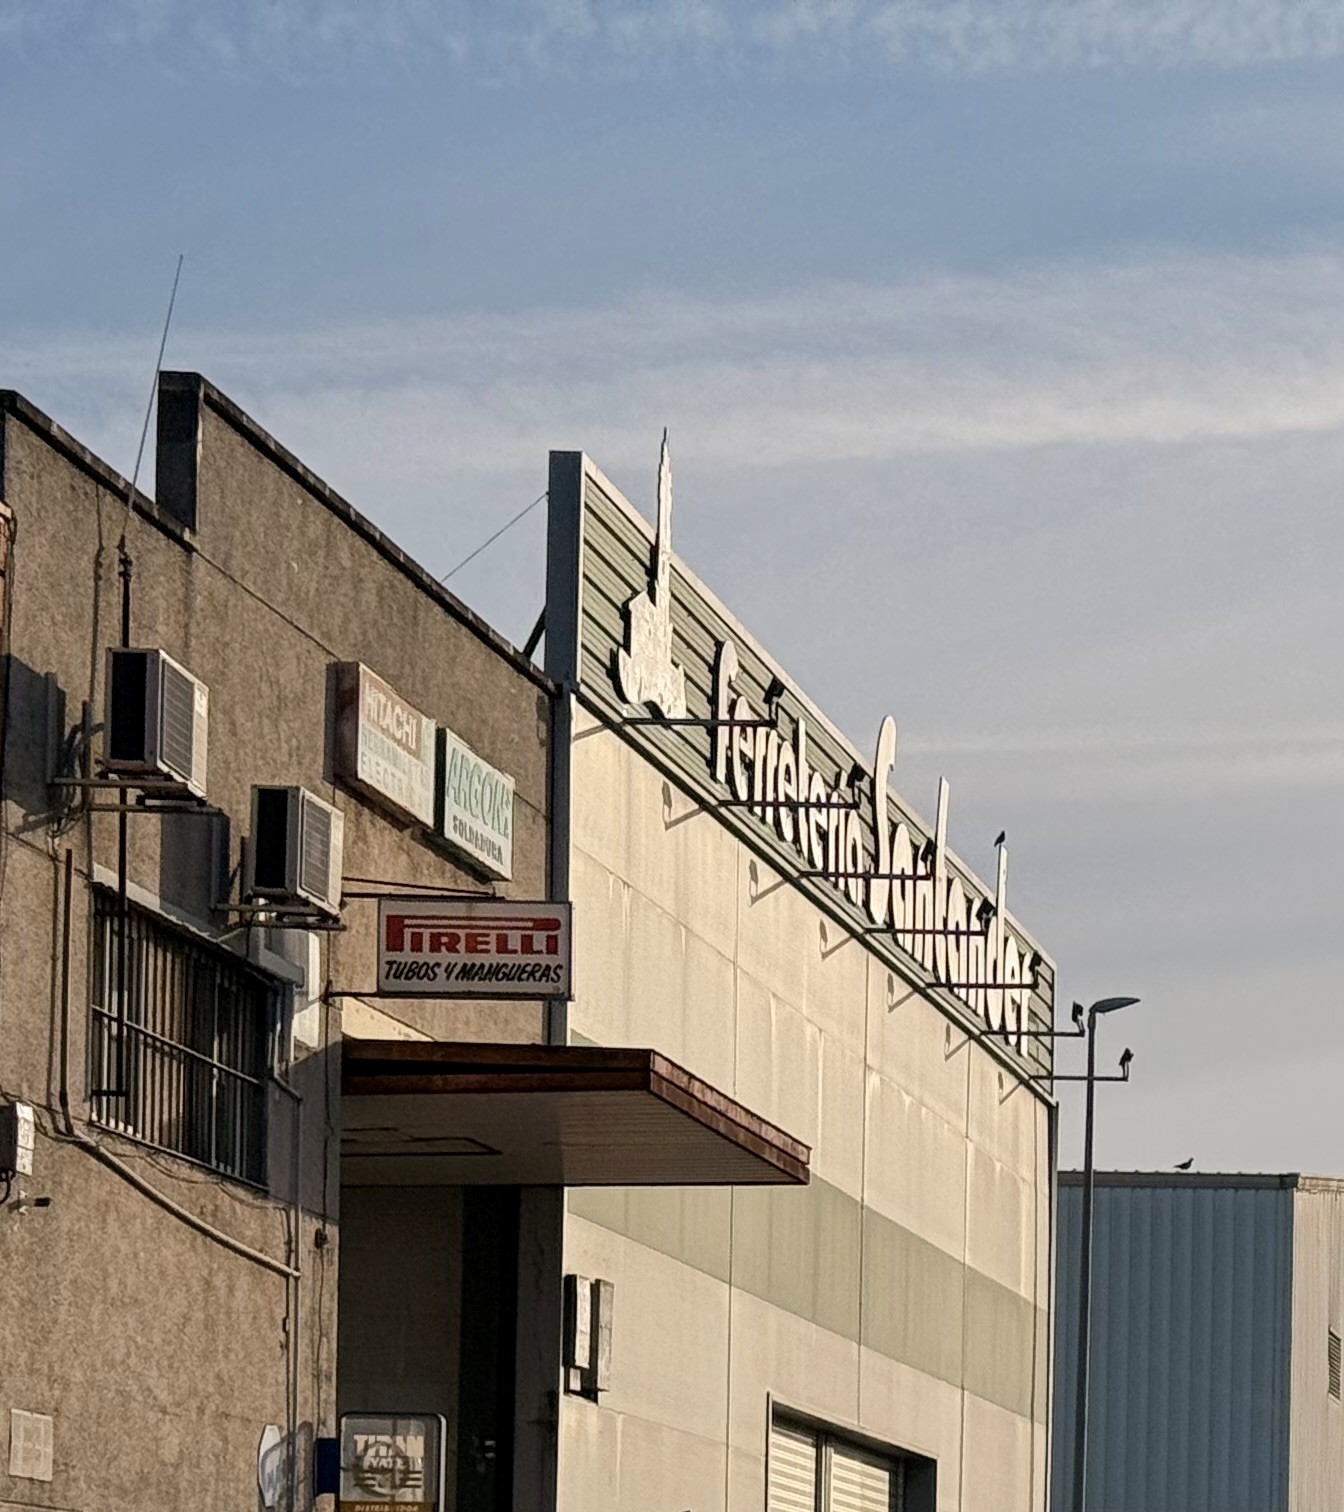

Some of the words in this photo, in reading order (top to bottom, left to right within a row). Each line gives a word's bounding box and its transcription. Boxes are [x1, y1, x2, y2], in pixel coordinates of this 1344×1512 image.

[364, 681, 418, 750] HITACHI
[869, 714, 1033, 1058] Santander
[386, 914, 561, 956] PIRELLI
[384, 960, 441, 982] TUBOS
[454, 962, 563, 984] MANGUERAS
